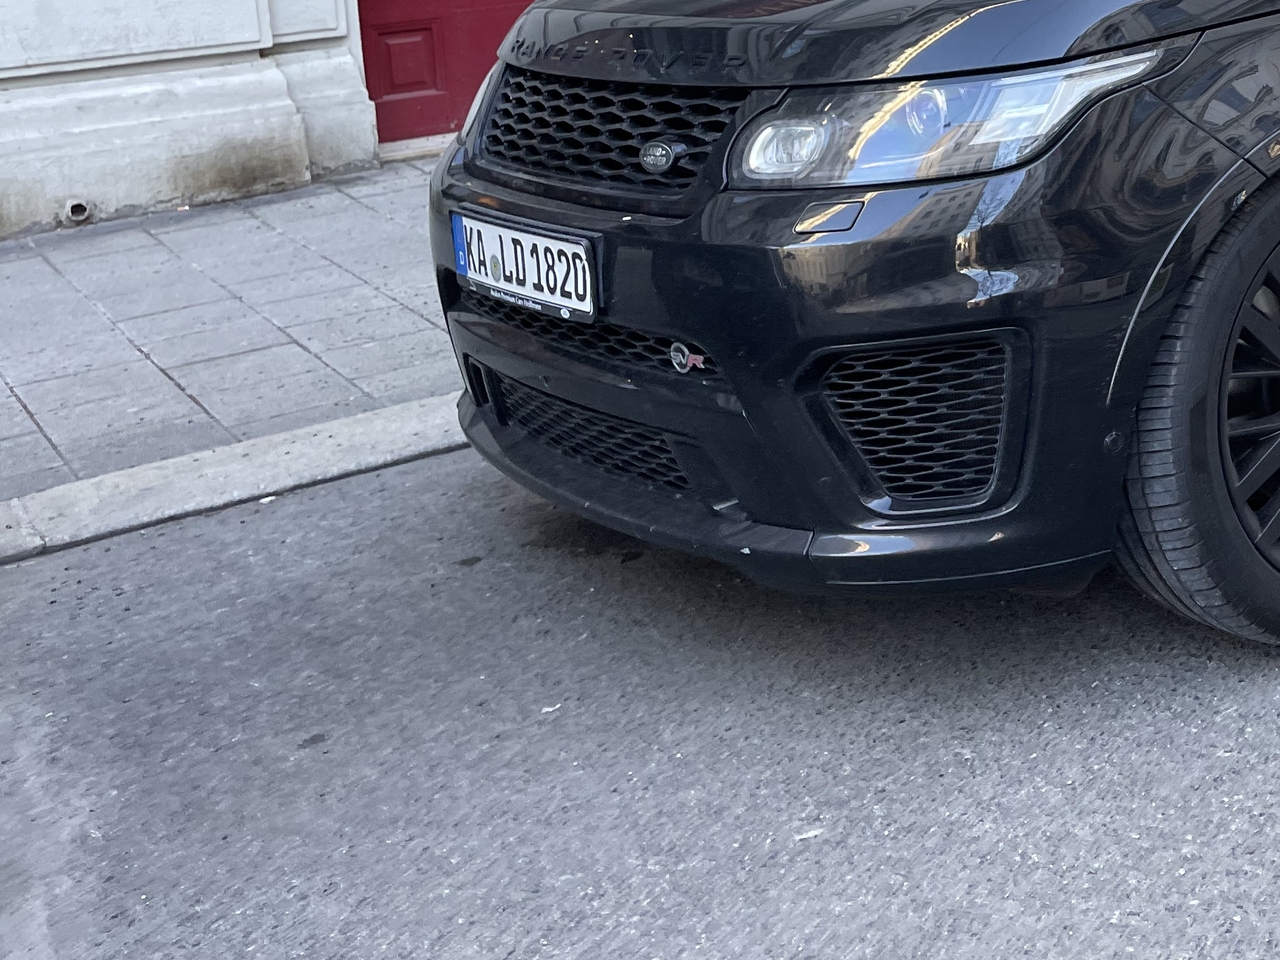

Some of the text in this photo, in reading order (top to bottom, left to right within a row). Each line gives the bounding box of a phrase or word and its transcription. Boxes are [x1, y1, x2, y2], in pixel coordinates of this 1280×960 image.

[511, 38, 748, 73] RANGE ROVER
[459, 250, 465, 266] D
[463, 224, 588, 302] KA LD 1820
[671, 346, 705, 371] SVR
